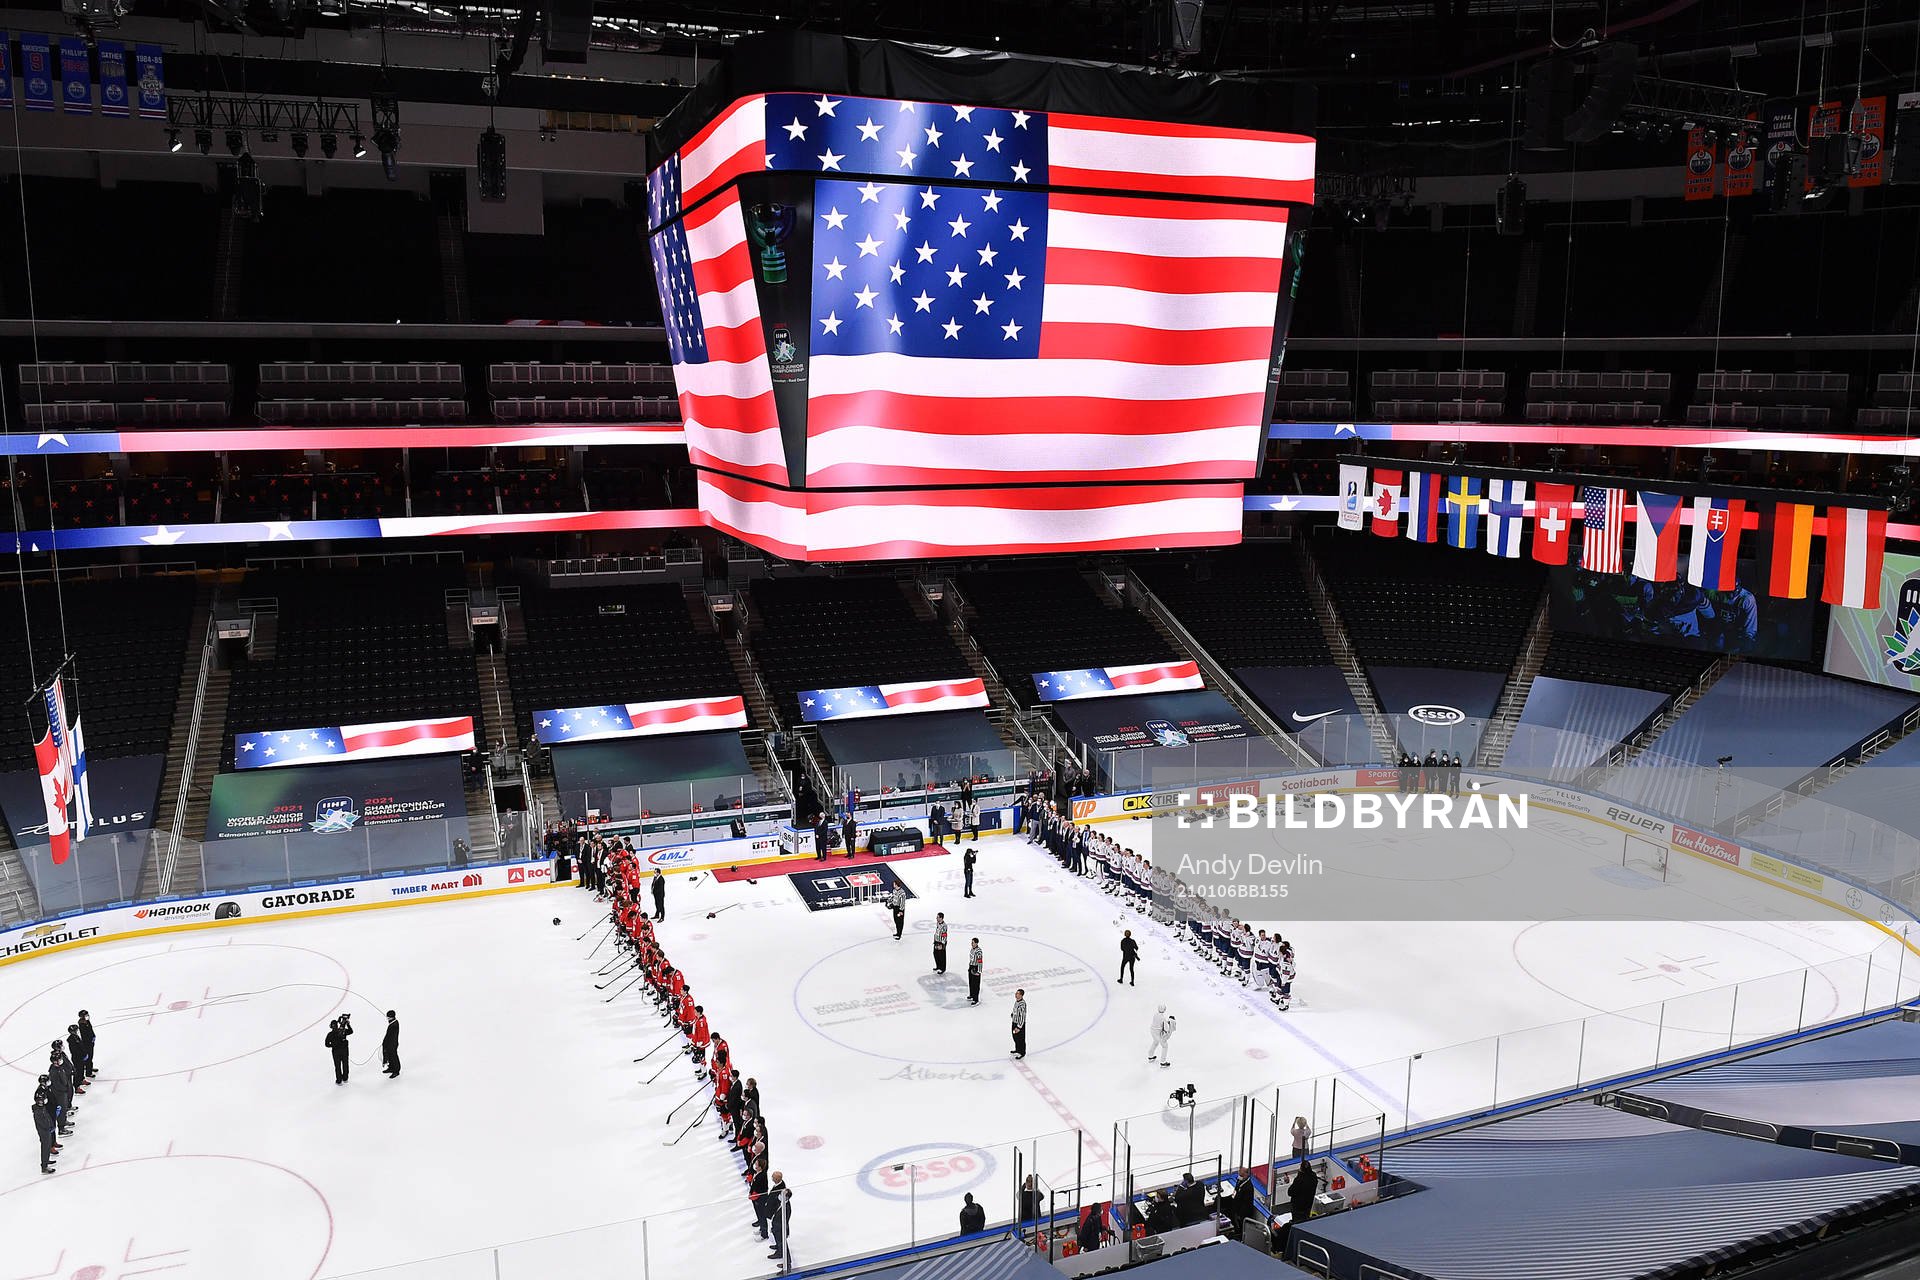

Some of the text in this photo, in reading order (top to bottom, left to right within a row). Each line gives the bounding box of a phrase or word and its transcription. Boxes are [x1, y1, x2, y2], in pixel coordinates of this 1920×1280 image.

[1281, 775, 1339, 791] Scotiabank
[365, 797, 394, 805] 2021
[1124, 793, 1179, 811] OK TIRE
[1555, 790, 1582, 802] TELUS
[273, 804, 303, 813] 2021
[322, 800, 347, 809] IIHF
[364, 800, 434, 811] CHAMPIONNAT
[364, 802, 445, 816] MONDIAL JUNIOR
[67, 811, 144, 830] TLUS
[227, 817, 304, 827] CHAMPIONSHIP
[228, 812, 304, 824] WORLD JUNIOR
[218, 830, 259, 838] Edmonton
[283, 826, 303, 834] Deer
[1675, 828, 1736, 863] Tim Hortons
[656, 851, 688, 861] AMJ
[392, 881, 459, 895] TIMBER MART
[262, 888, 355, 909] GATORADE
[880, 1063, 990, 1081] Alberta
